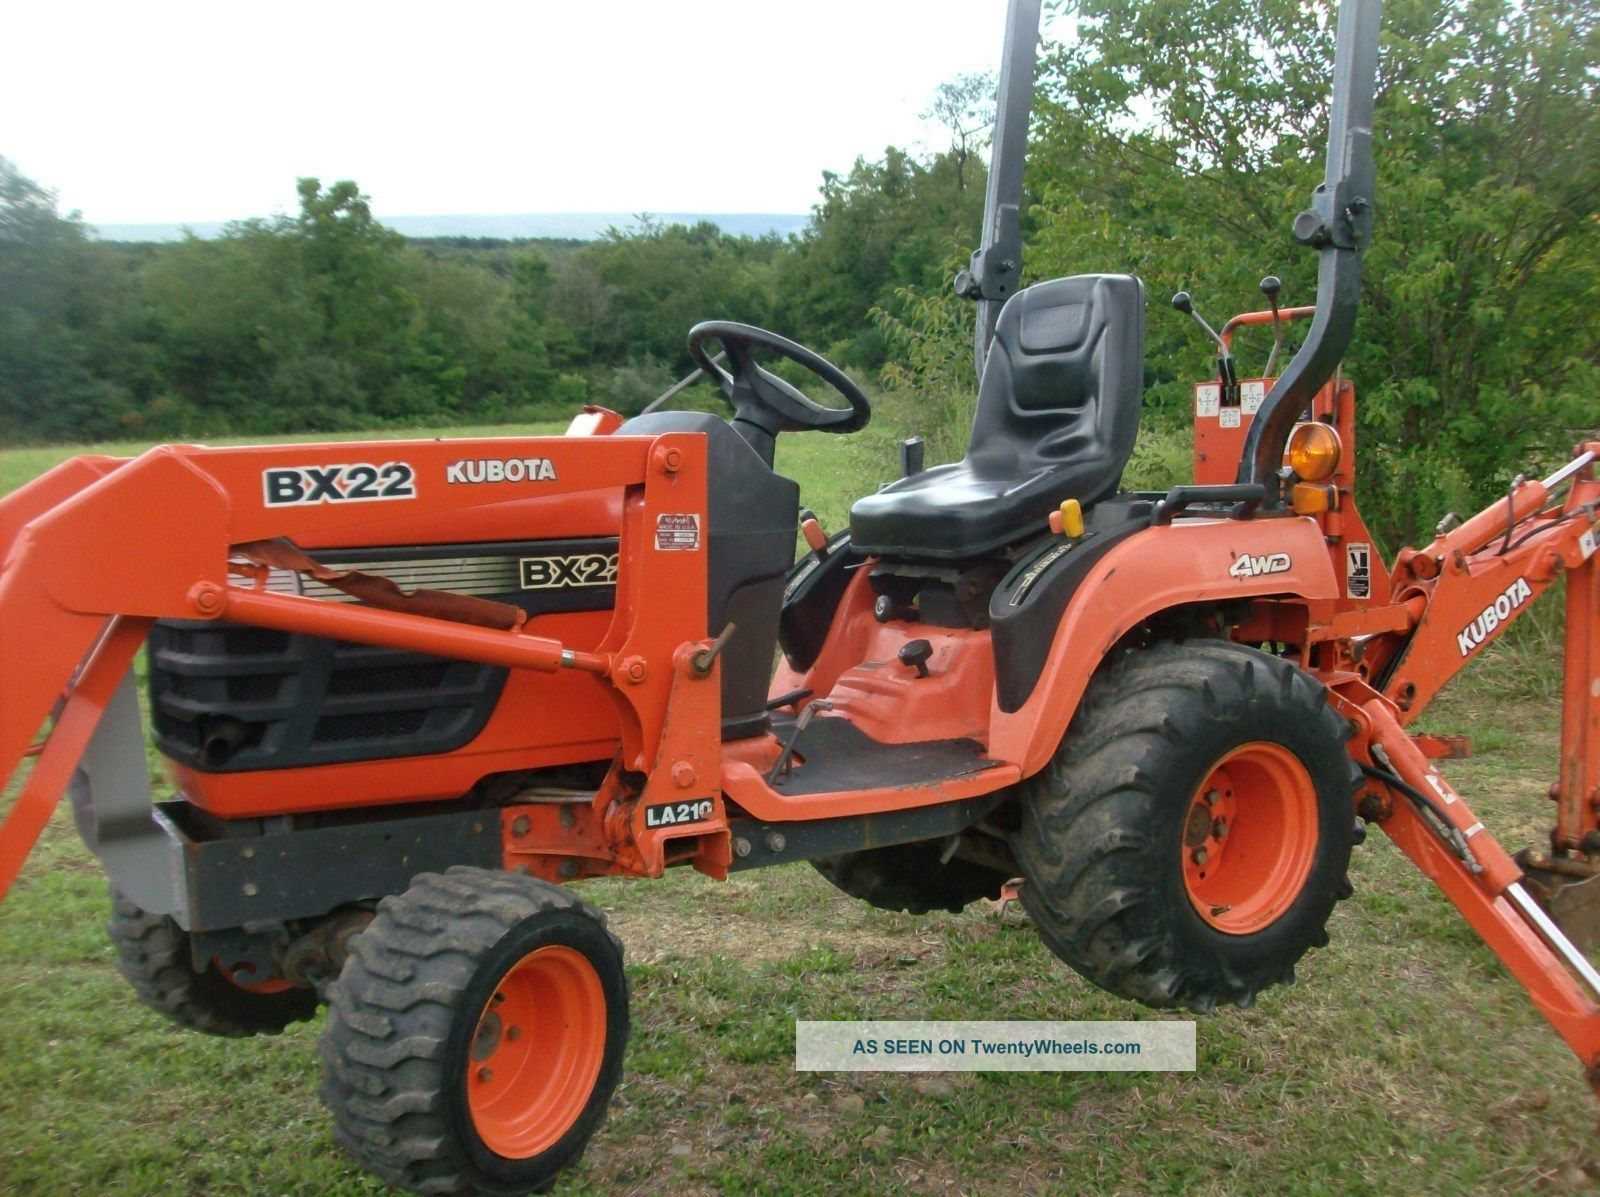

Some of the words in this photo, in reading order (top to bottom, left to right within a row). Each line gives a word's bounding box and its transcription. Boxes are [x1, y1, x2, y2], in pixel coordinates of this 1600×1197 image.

[447, 459, 557, 483] KUBOTA
[264, 462, 416, 507] BX22
[1229, 552, 1292, 577] 4WD
[1456, 576, 1533, 658] KUBOTA
[647, 801, 713, 827] LA210
